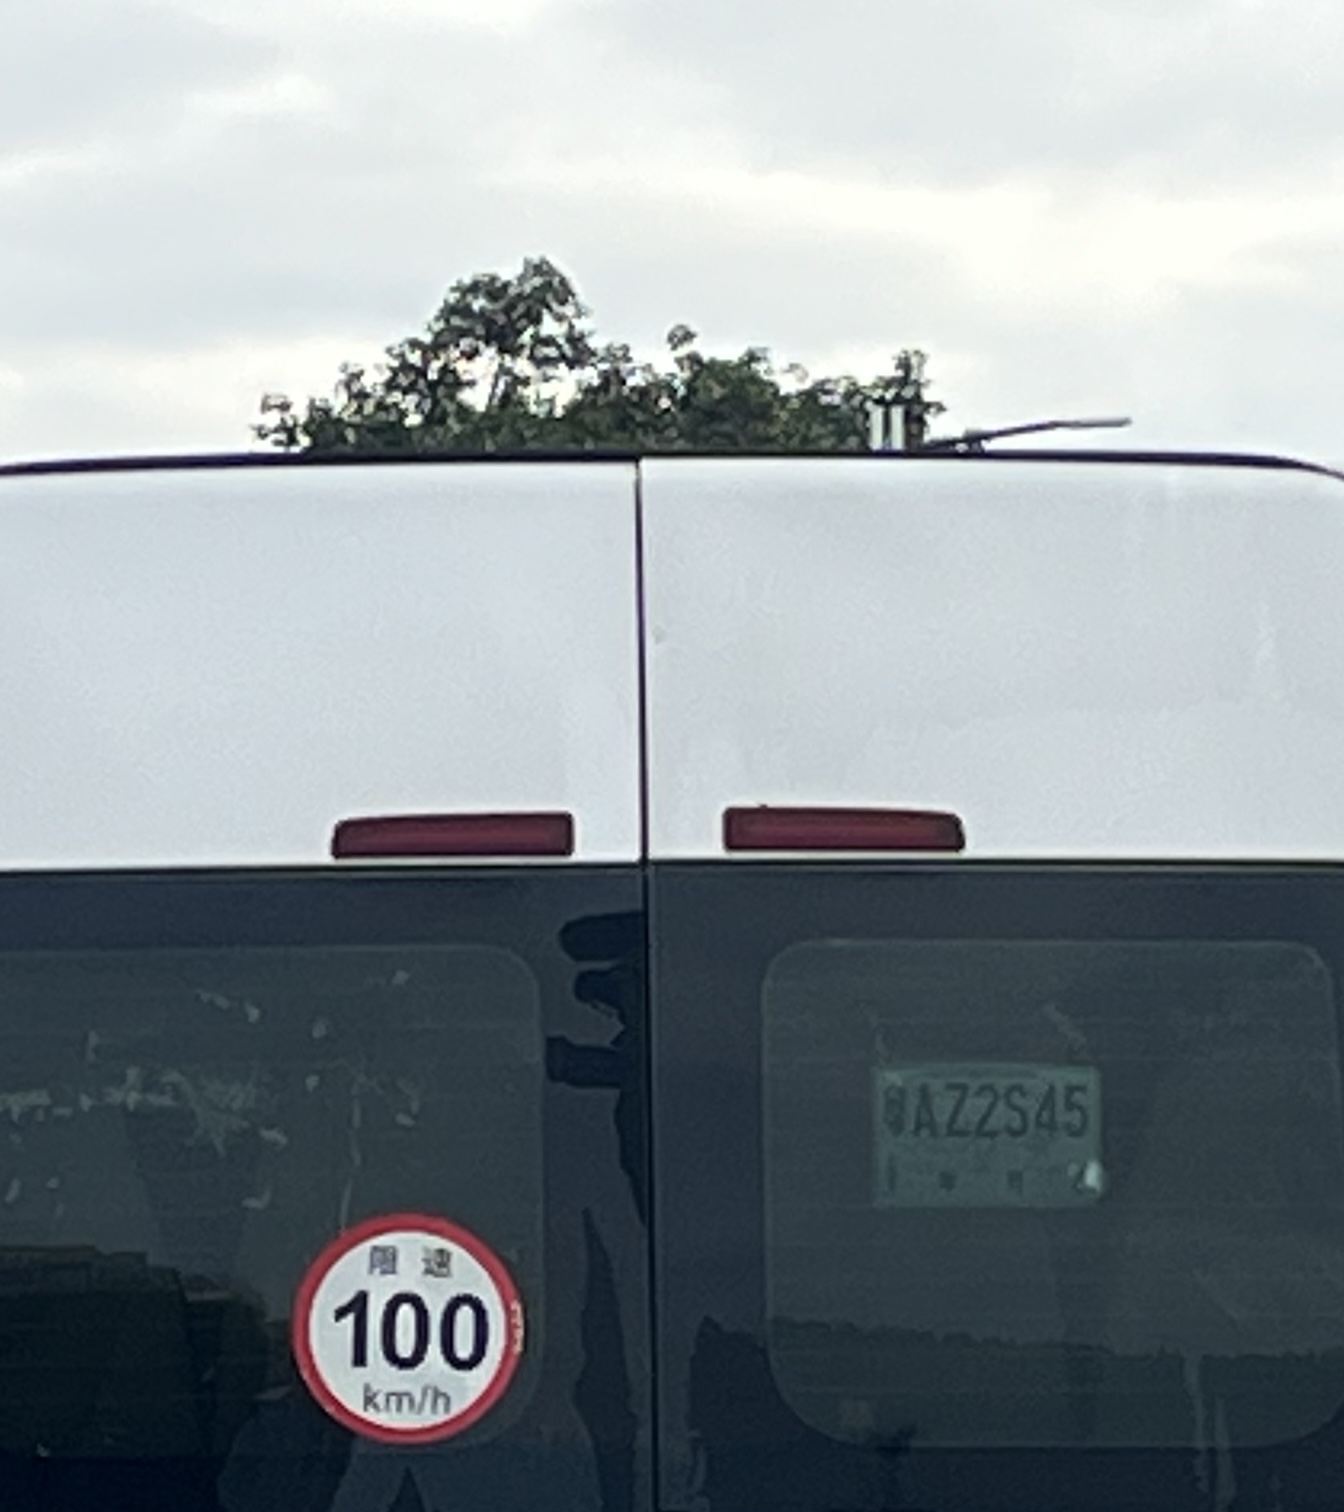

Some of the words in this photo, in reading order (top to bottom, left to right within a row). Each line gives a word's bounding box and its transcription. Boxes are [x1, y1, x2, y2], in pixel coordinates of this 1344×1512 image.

[369, 1245, 453, 1279] 限速
[333, 1290, 490, 1371] 100
[362, 1383, 452, 1415] km/h
